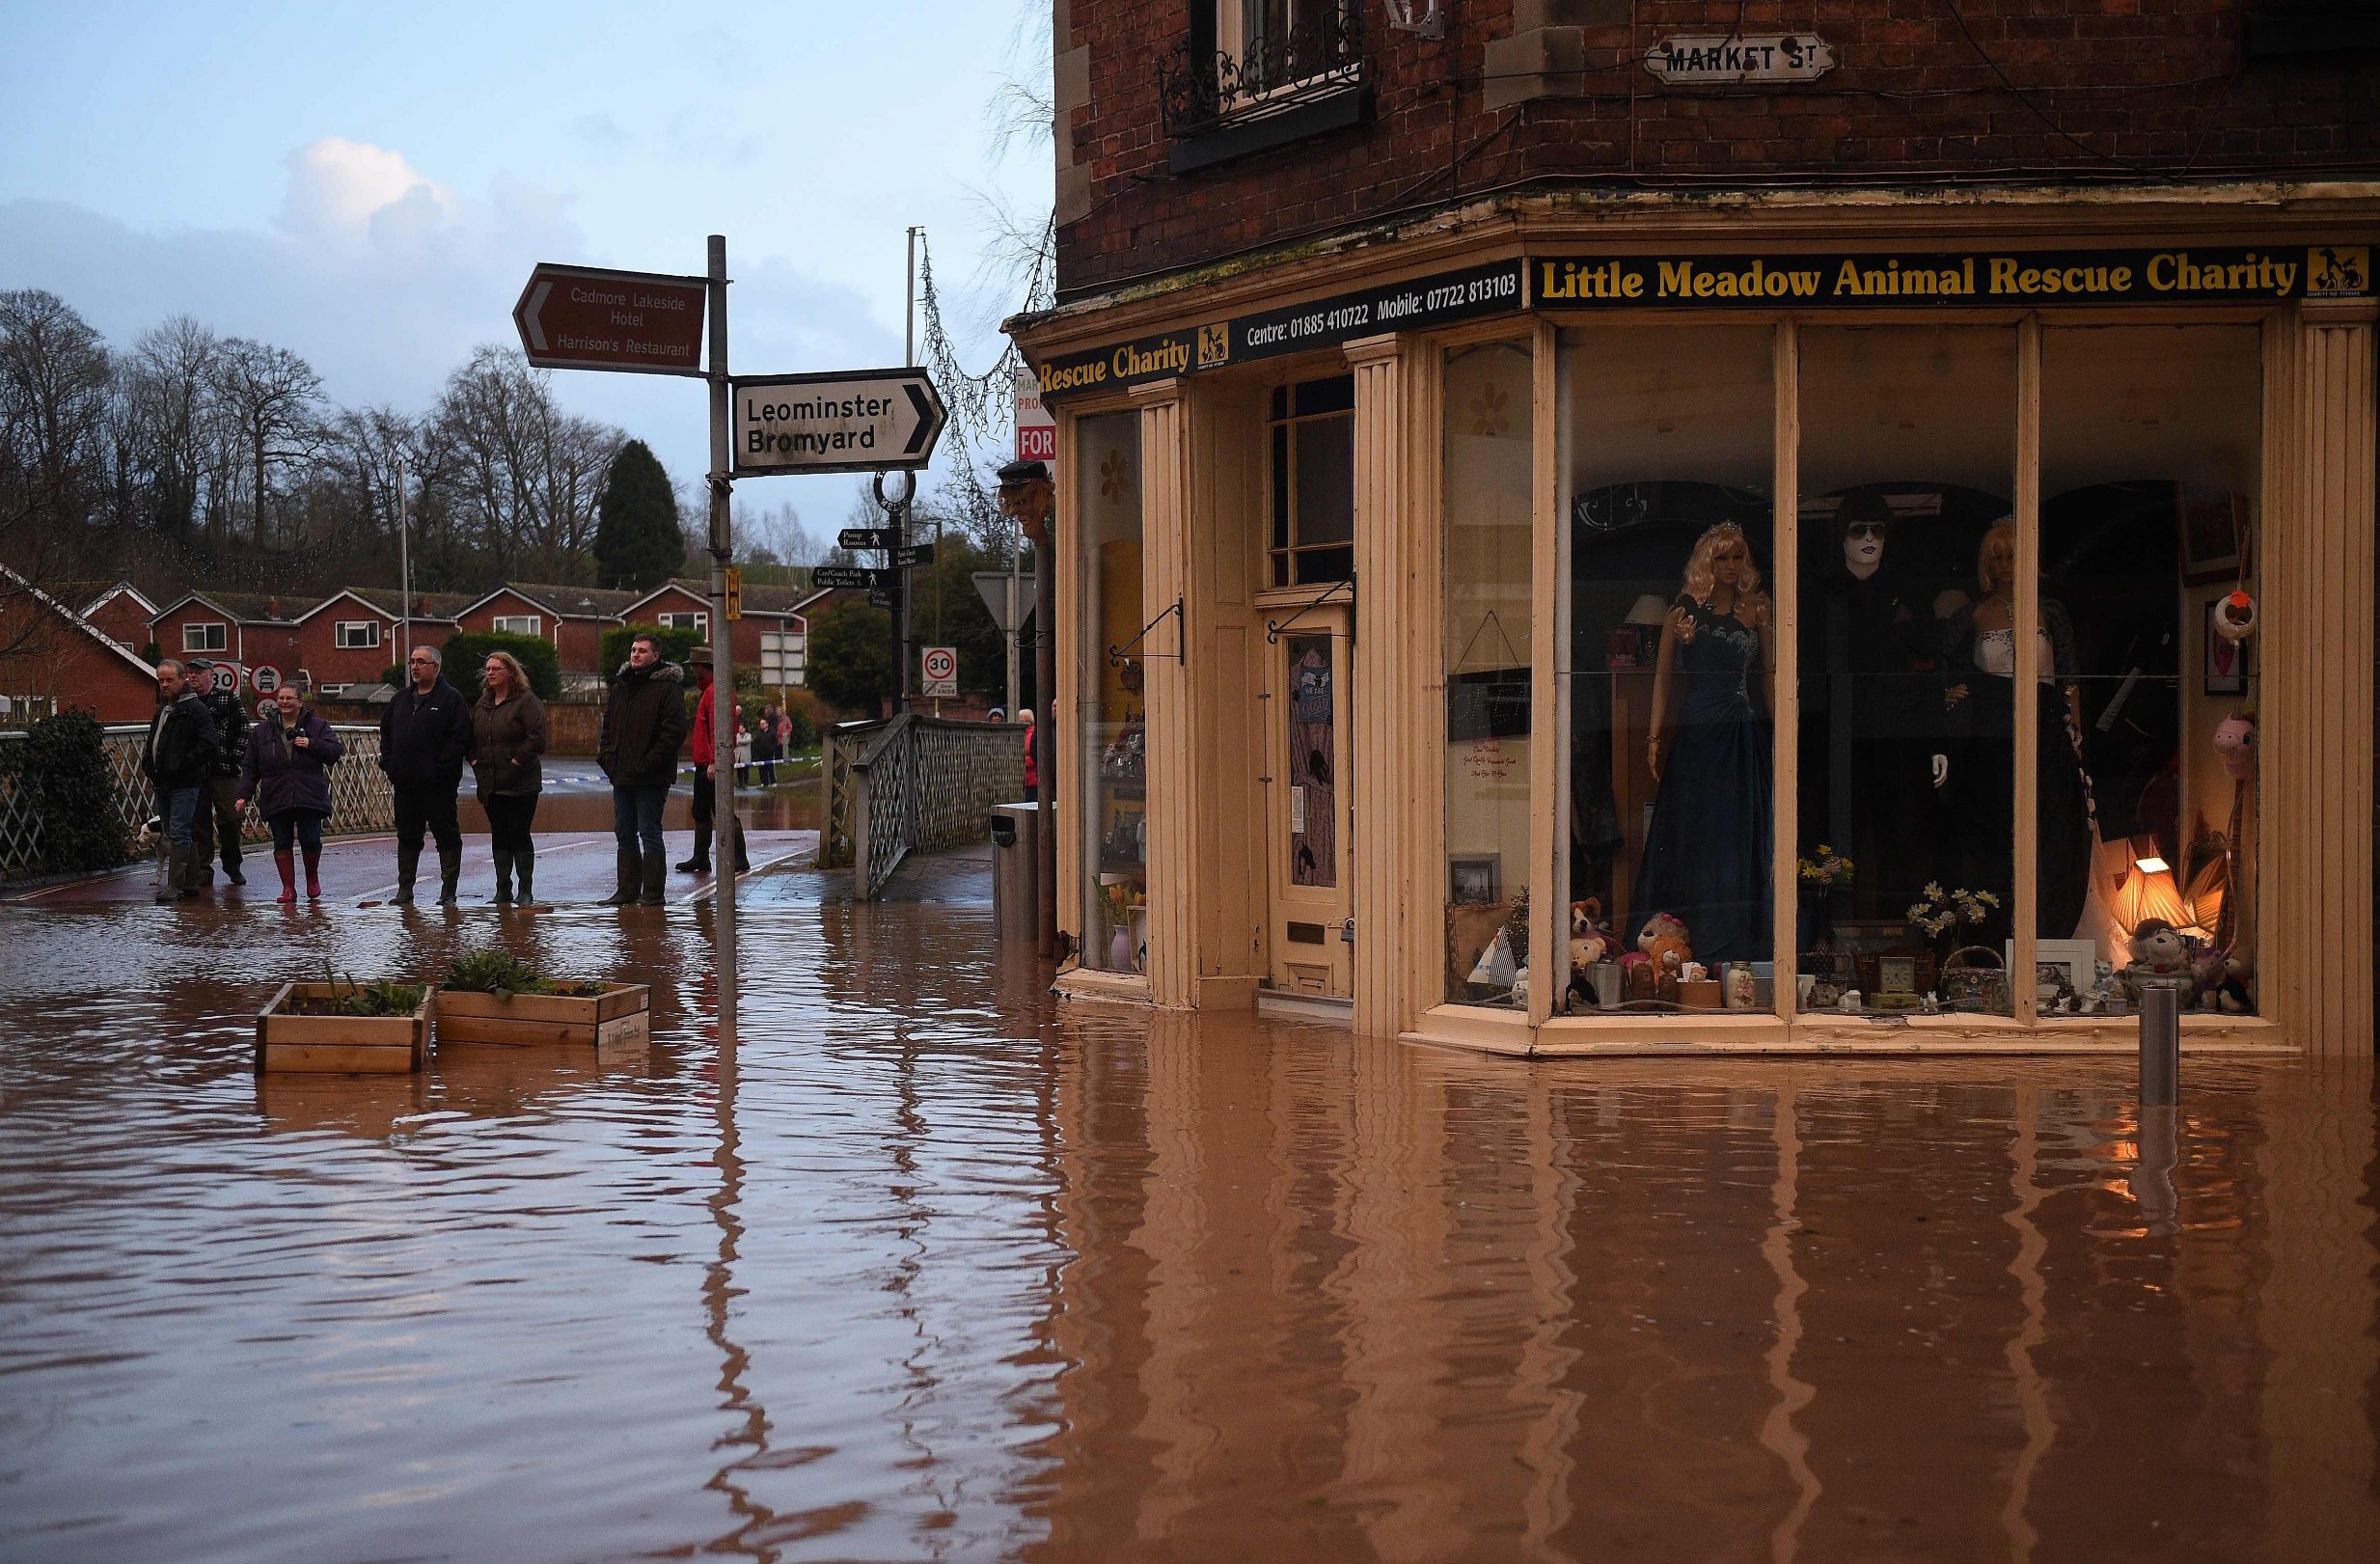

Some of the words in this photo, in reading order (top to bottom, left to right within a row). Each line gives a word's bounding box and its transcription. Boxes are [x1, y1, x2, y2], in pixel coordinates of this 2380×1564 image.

[1666, 46, 1775, 71] MARKET
[1542, 261, 1644, 298] Little
[1656, 260, 1821, 297] Meadow
[1833, 257, 1976, 295] Animal
[1988, 258, 2132, 294] Rescue
[2147, 253, 2297, 296] Charity
[571, 288, 626, 305] Cadmore
[633, 293, 686, 311] Lakeside
[1246, 323, 1288, 346] Centre:
[1290, 314, 1324, 338] 01885
[1327, 304, 1369, 331] 410722
[1377, 292, 1423, 321] Mobile:
[1427, 284, 1464, 311] 07722
[1468, 273, 1516, 303] 813103
[611, 311, 643, 327] Hotel
[558, 333, 619, 352] Harrison's
[627, 339, 690, 357] Restaurant
[1040, 363, 1107, 394] Rescue
[1112, 339, 1190, 379] Charity
[748, 394, 892, 422] Leominster
[748, 425, 875, 455] Bromyard
[1021, 430, 1054, 455] FOR
[843, 531, 862, 539] Pump
[816, 568, 848, 577] Car/Coach
[817, 577, 834, 586] Public
[930, 657, 950, 671] 30
